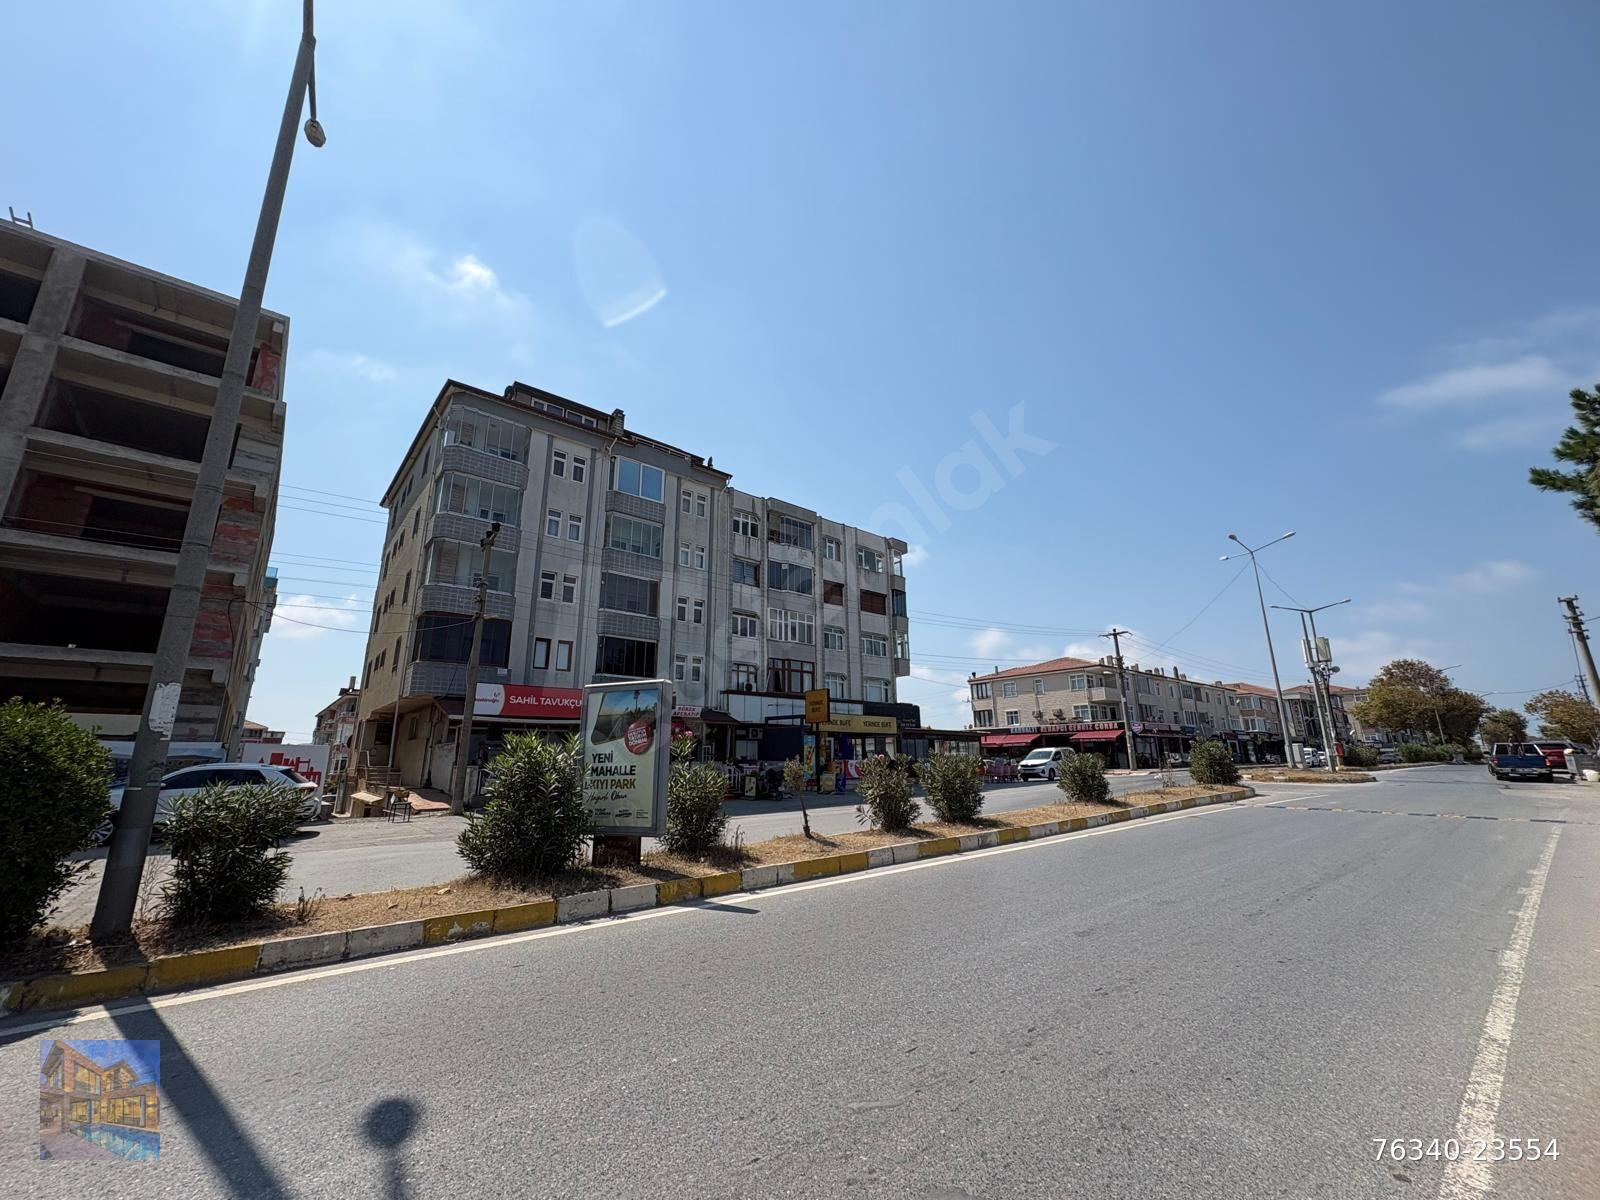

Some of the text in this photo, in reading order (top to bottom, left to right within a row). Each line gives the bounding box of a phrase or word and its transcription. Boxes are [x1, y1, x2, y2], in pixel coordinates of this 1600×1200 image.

[509, 694, 538, 705] SAHİL
[540, 697, 582, 709] TAVUKÇU
[592, 750, 614, 763] YENİ
[591, 765, 637, 777] MAHALLE
[610, 778, 636, 789] PARK
